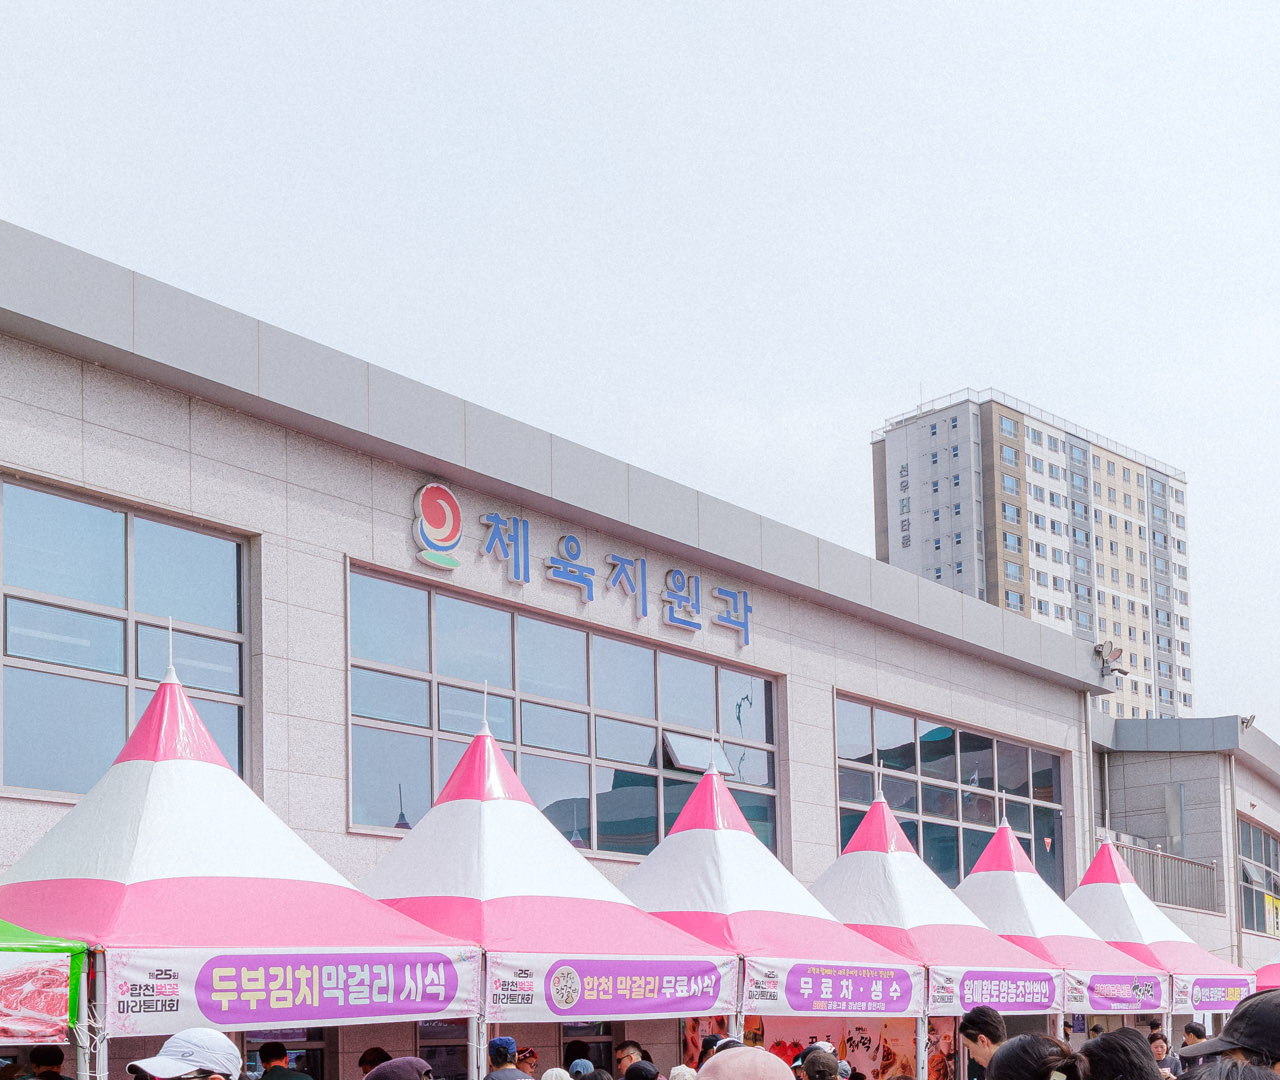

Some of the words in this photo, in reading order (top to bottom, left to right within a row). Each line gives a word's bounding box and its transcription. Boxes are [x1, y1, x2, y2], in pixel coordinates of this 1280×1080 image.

[479, 512, 753, 648] 체육지원과
[130, 983, 180, 998] 합천벚꽃
[399, 961, 447, 1003] 시식
[583, 976, 614, 1000] 합천
[616, 976, 660, 1000] 막걸리
[117, 998, 180, 1014] 마라톤대회
[492, 993, 534, 1005] 마라톤대회
